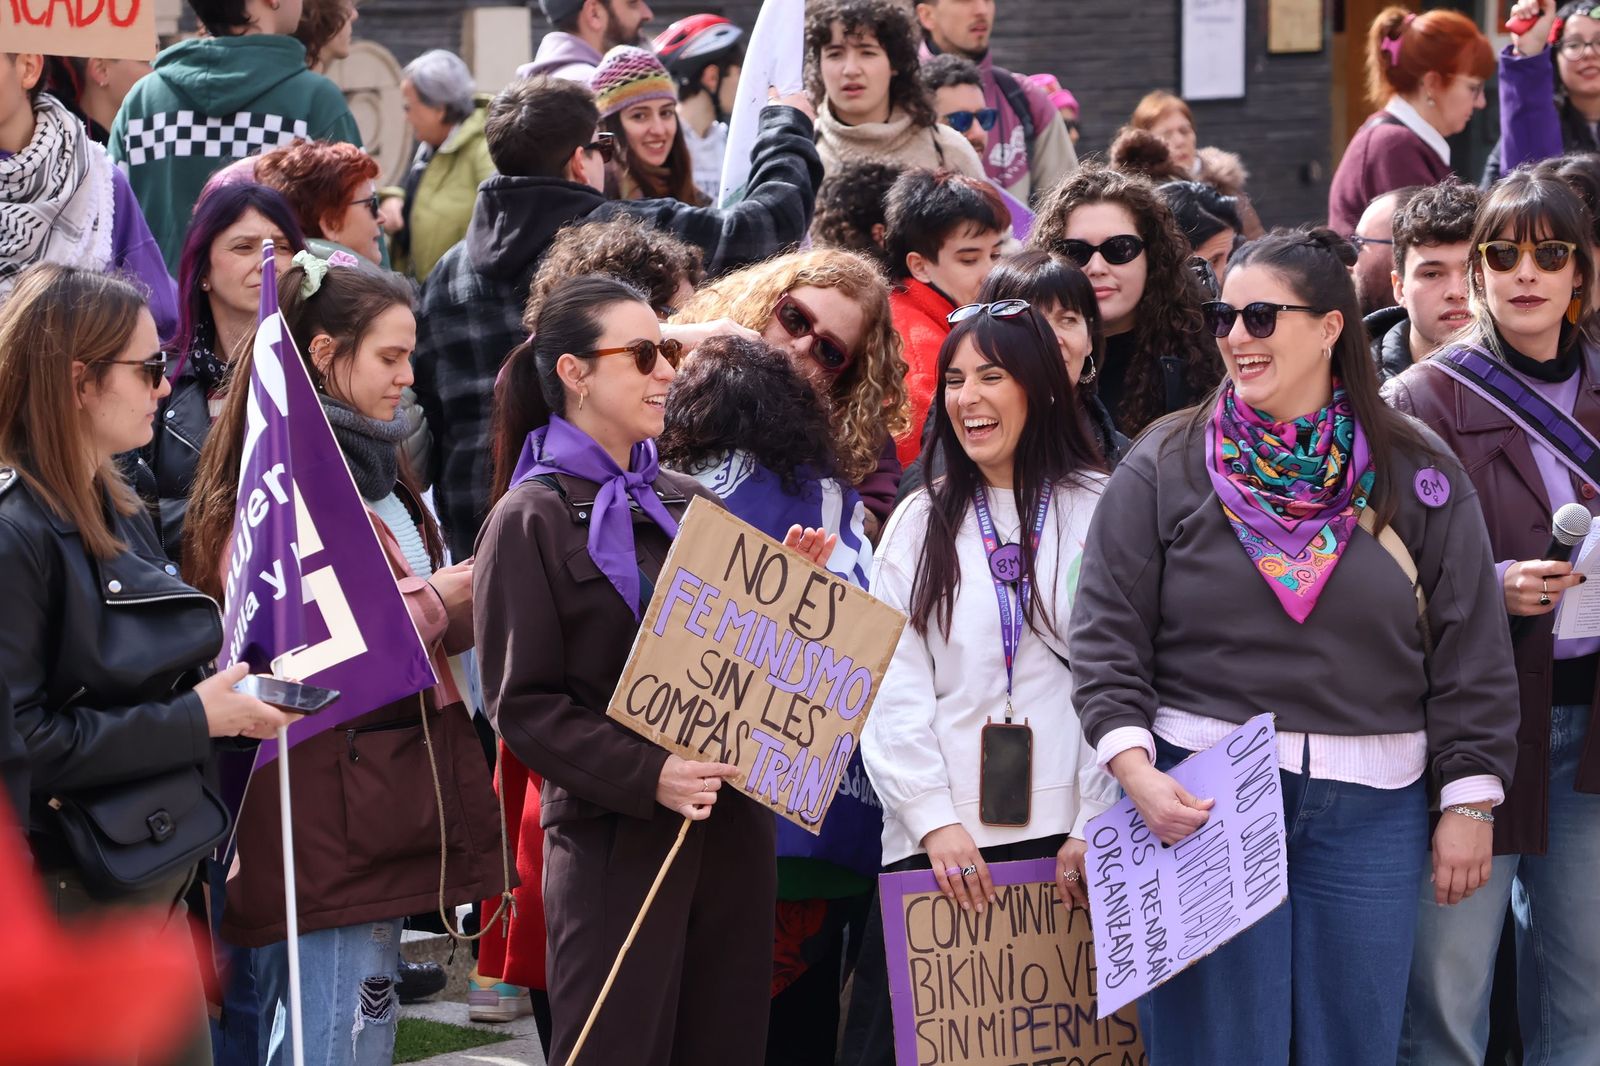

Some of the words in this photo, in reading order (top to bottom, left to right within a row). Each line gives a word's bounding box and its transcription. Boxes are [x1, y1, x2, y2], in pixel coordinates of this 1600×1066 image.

[1420, 478, 1445, 497] 8M
[258, 558, 288, 601] y
[723, 532, 789, 606] NO
[789, 570, 847, 642] ES
[995, 555, 1021, 575] 8M
[652, 565, 873, 721] FEMINISMO
[686, 649, 755, 711] SIN
[760, 680, 828, 748] LES
[626, 673, 750, 767] COMPAS
[744, 730, 854, 826] TRANS
[1226, 725, 1271, 767] SI
[1234, 753, 1279, 814] NOS
[1125, 807, 1156, 867] NOS
[1240, 811, 1286, 911] QUIEREN
[905, 894, 980, 954] CON
[1092, 825, 1138, 990] ORGANIZADAS
[1173, 819, 1242, 961] ENFRENTADAS
